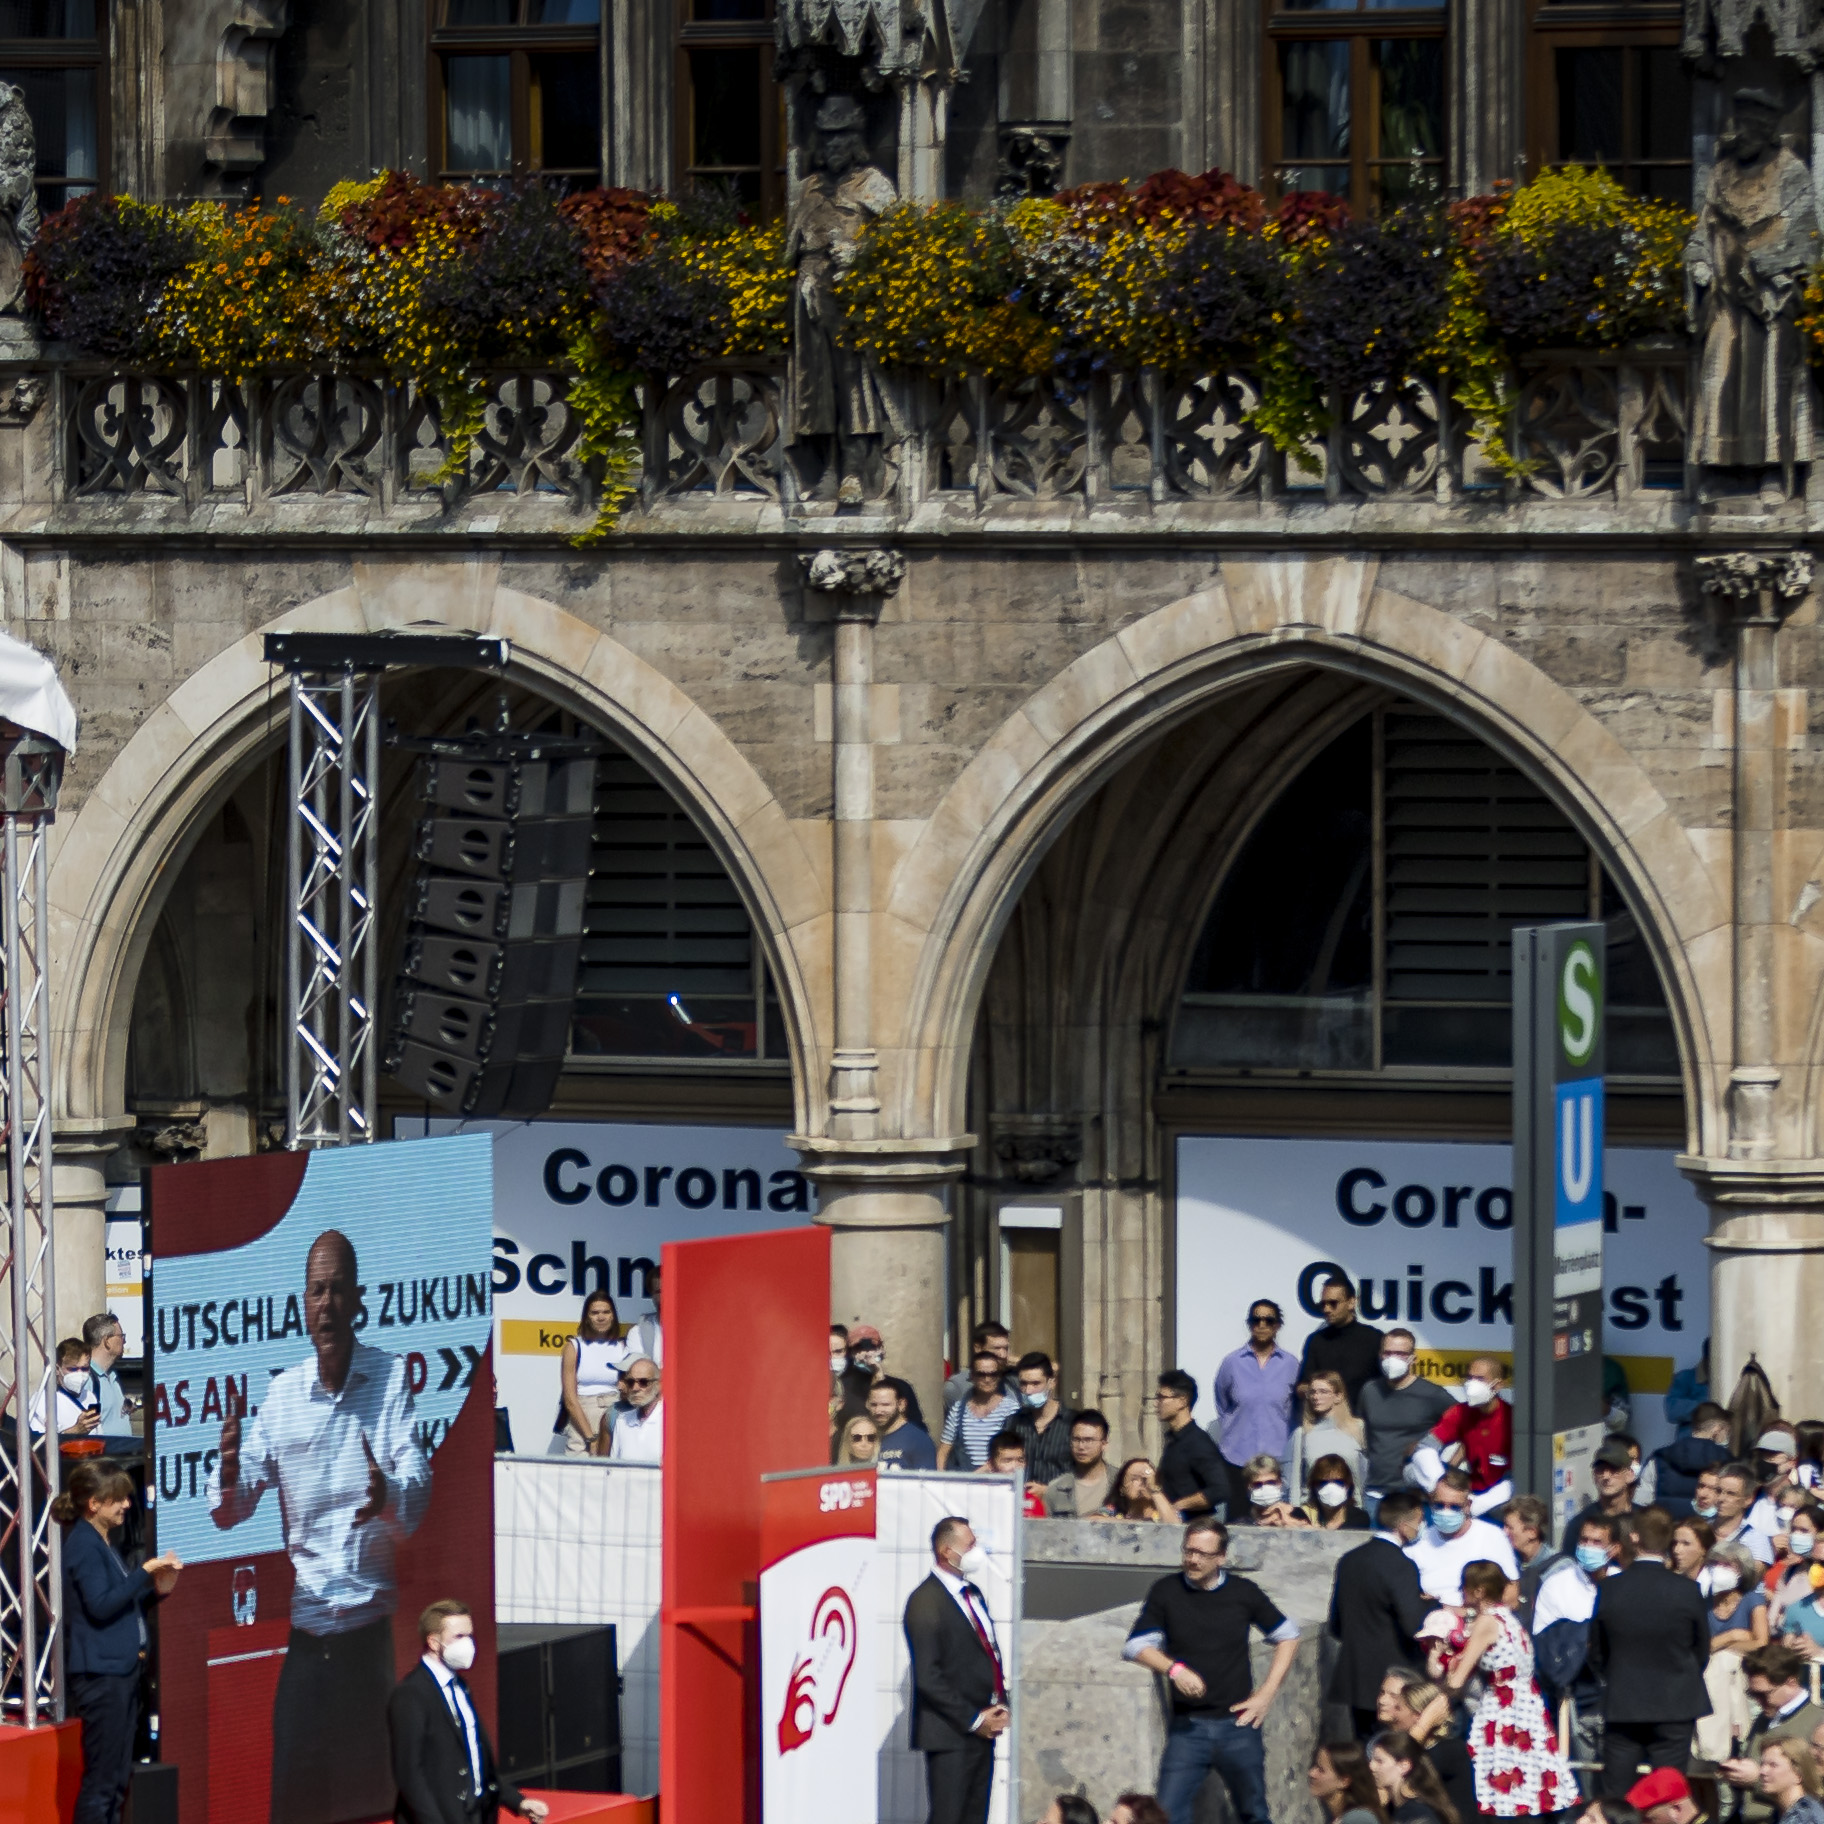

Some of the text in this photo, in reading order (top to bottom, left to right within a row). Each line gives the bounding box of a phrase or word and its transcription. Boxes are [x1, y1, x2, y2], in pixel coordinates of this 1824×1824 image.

[1562, 947, 1596, 1058] S
[543, 1148, 818, 1212] Corona
[1561, 1096, 1593, 1204] U
[492, 1237, 657, 1298] Schn
